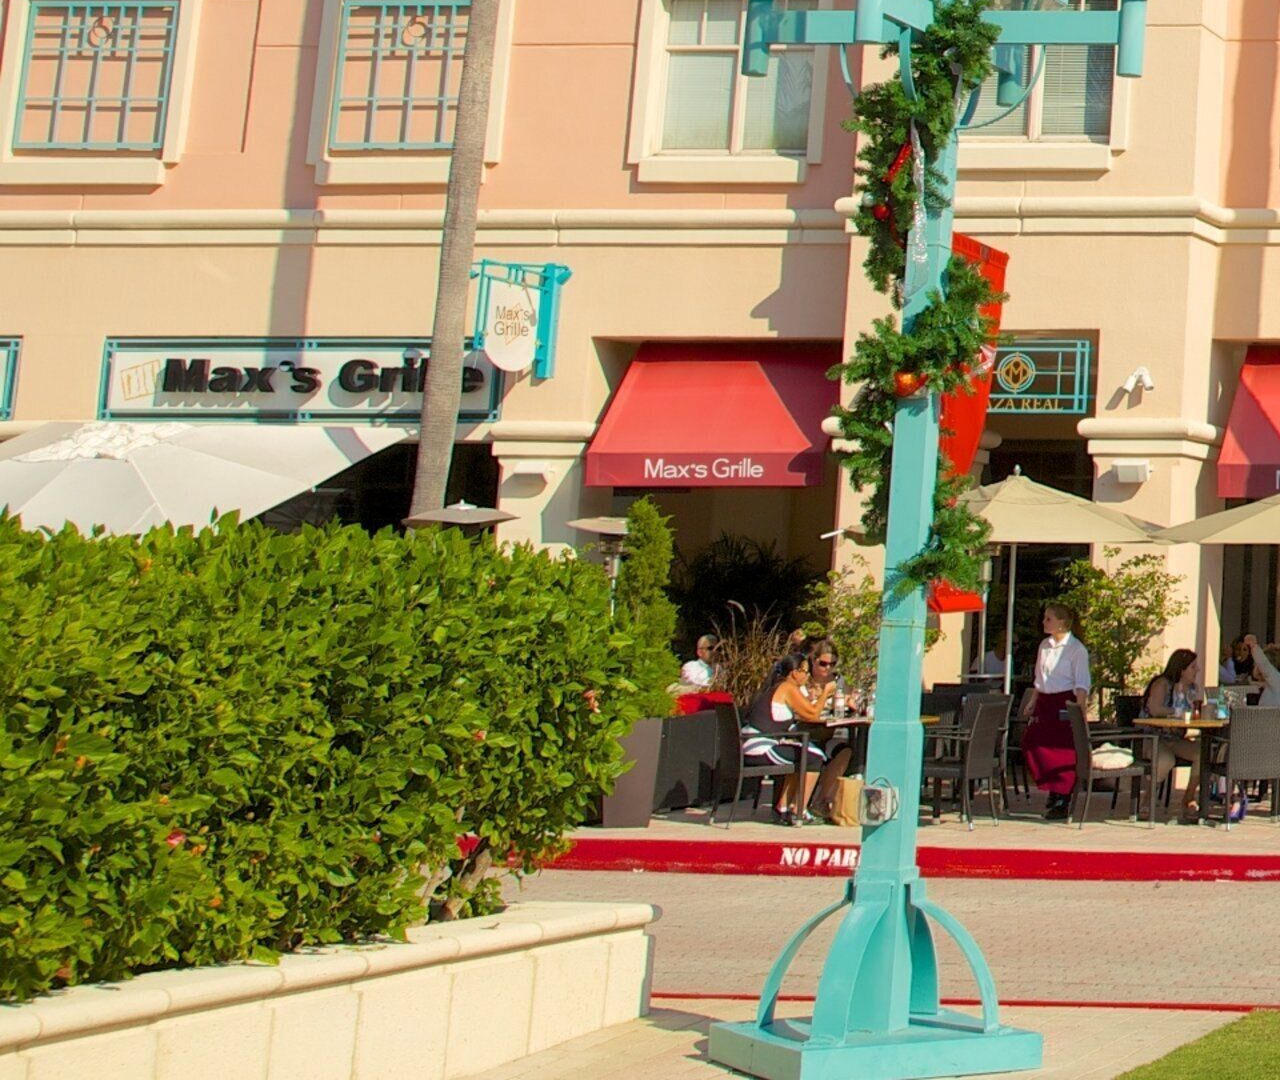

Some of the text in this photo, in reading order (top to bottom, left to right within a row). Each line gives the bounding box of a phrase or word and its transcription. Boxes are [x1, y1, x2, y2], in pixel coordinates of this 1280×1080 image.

[496, 305, 531, 321] Max's
[494, 321, 529, 337] Grille
[162, 358, 485, 393] Max's Grile
[1021, 398, 1064, 410] REAL
[643, 457, 765, 479] Max's Grille
[779, 847, 860, 867] NO PAR
